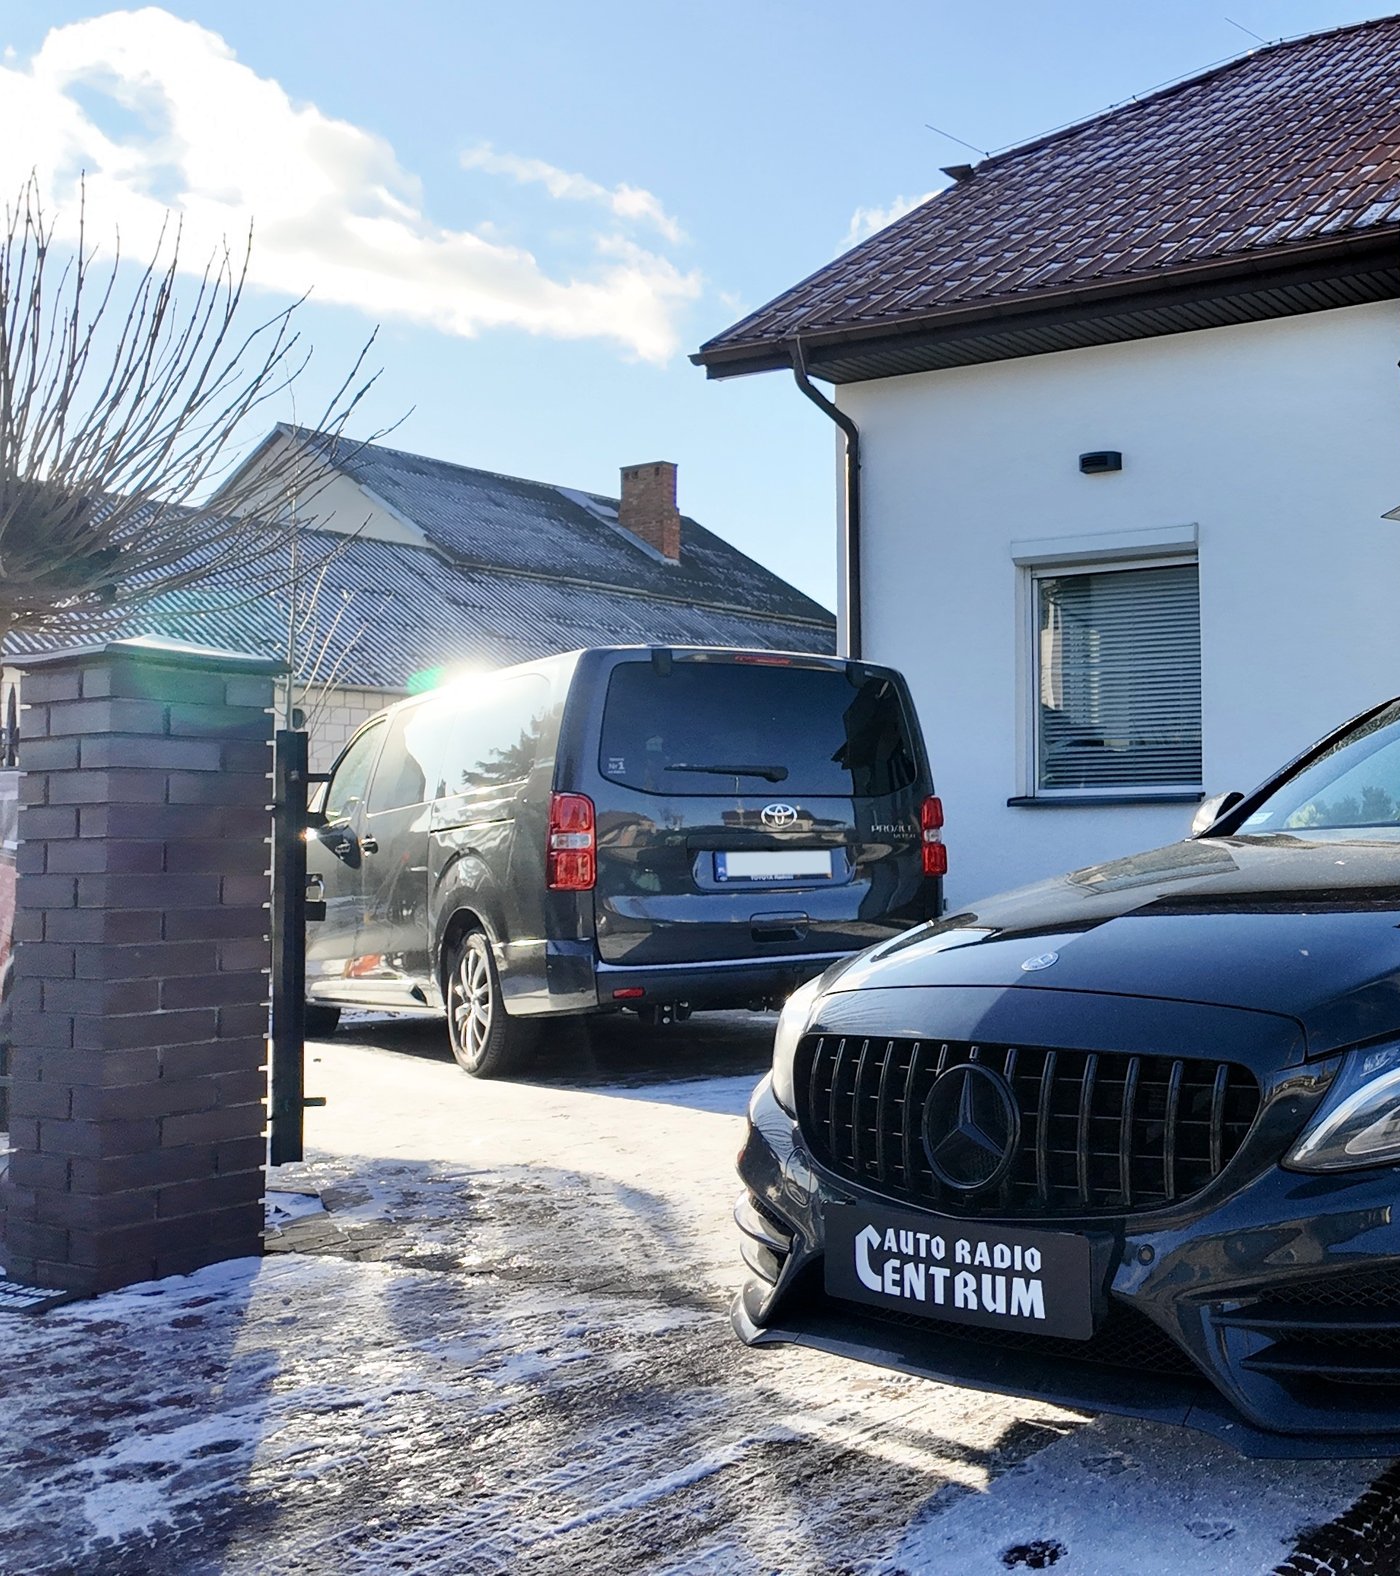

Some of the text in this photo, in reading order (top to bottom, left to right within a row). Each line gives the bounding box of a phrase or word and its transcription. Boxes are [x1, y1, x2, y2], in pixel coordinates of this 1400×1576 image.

[854, 1223, 1046, 1320] CENTRUM
[882, 1227, 1042, 1273] AUTO RADIO
